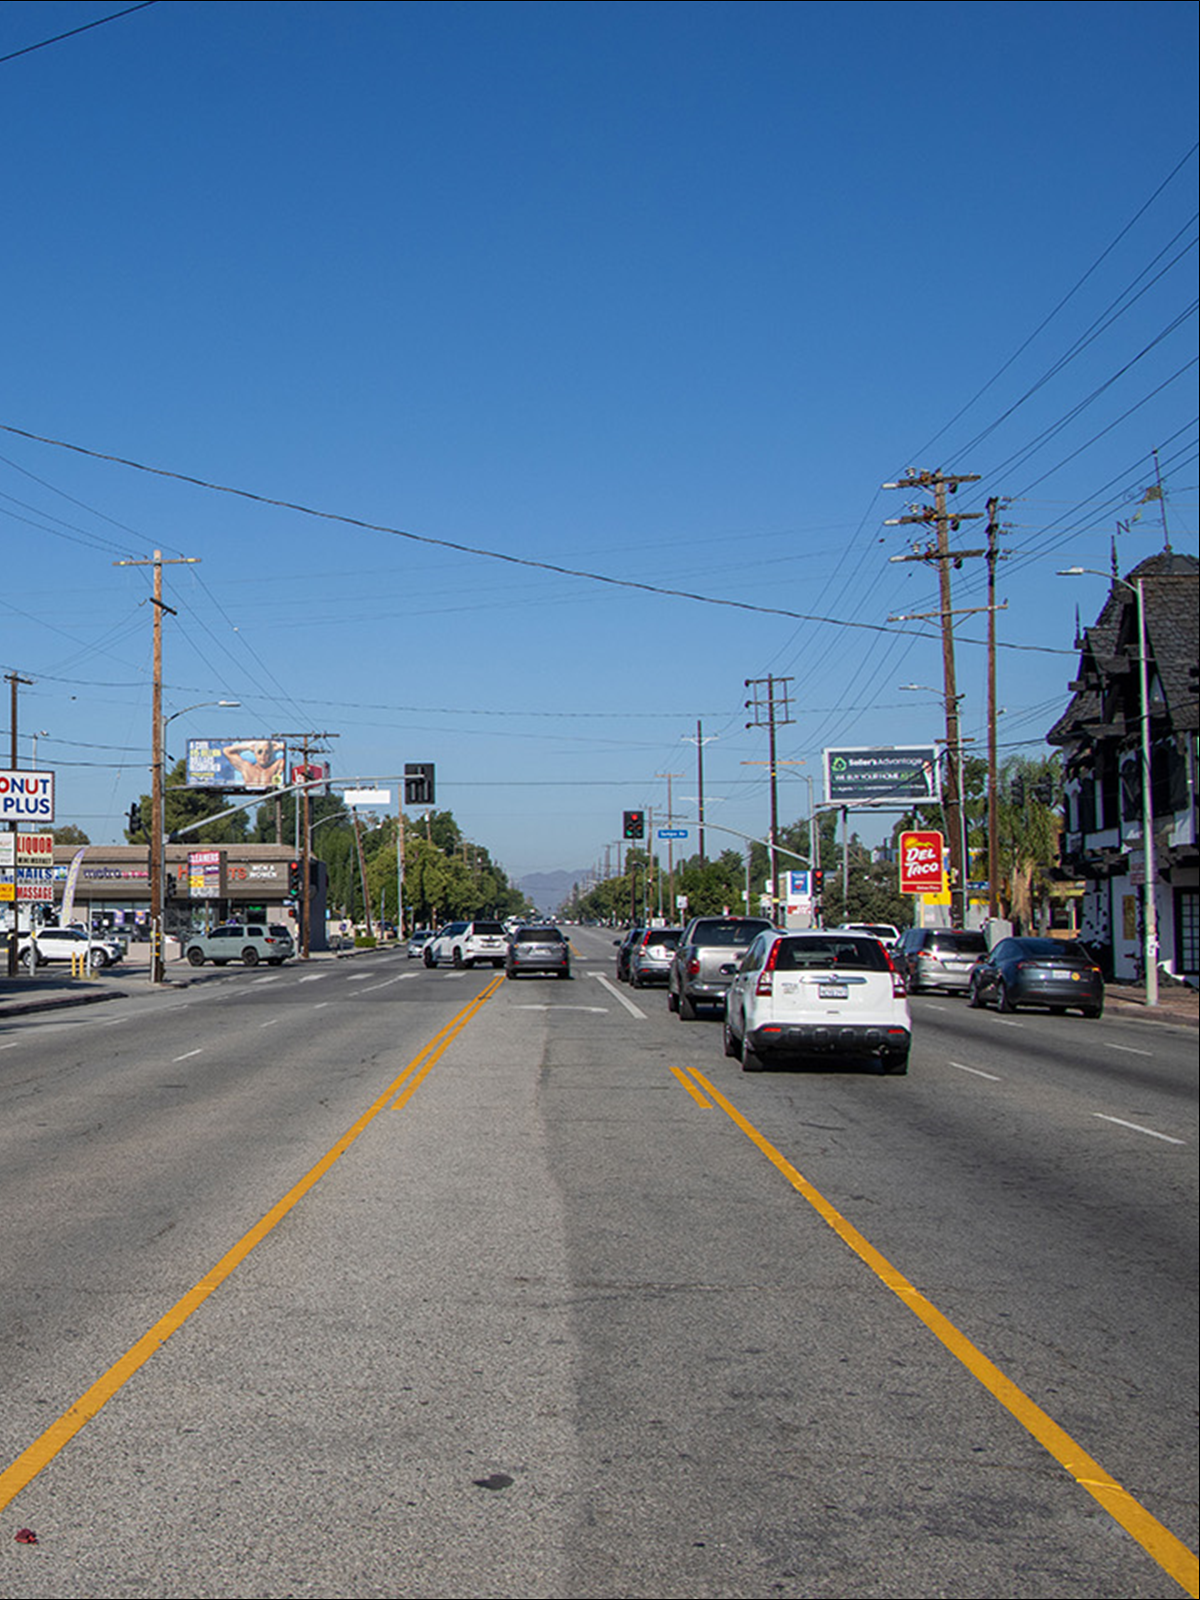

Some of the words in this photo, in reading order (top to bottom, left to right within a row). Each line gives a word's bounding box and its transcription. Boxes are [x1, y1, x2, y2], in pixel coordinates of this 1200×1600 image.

[877, 758, 923, 767] Advantage
[3, 797, 50, 814] PLUS
[17, 836, 53, 855] LIQUOR
[17, 868, 53, 879] NAILS
[83, 867, 121, 879] metro
[17, 886, 53, 900] MASSAGE
